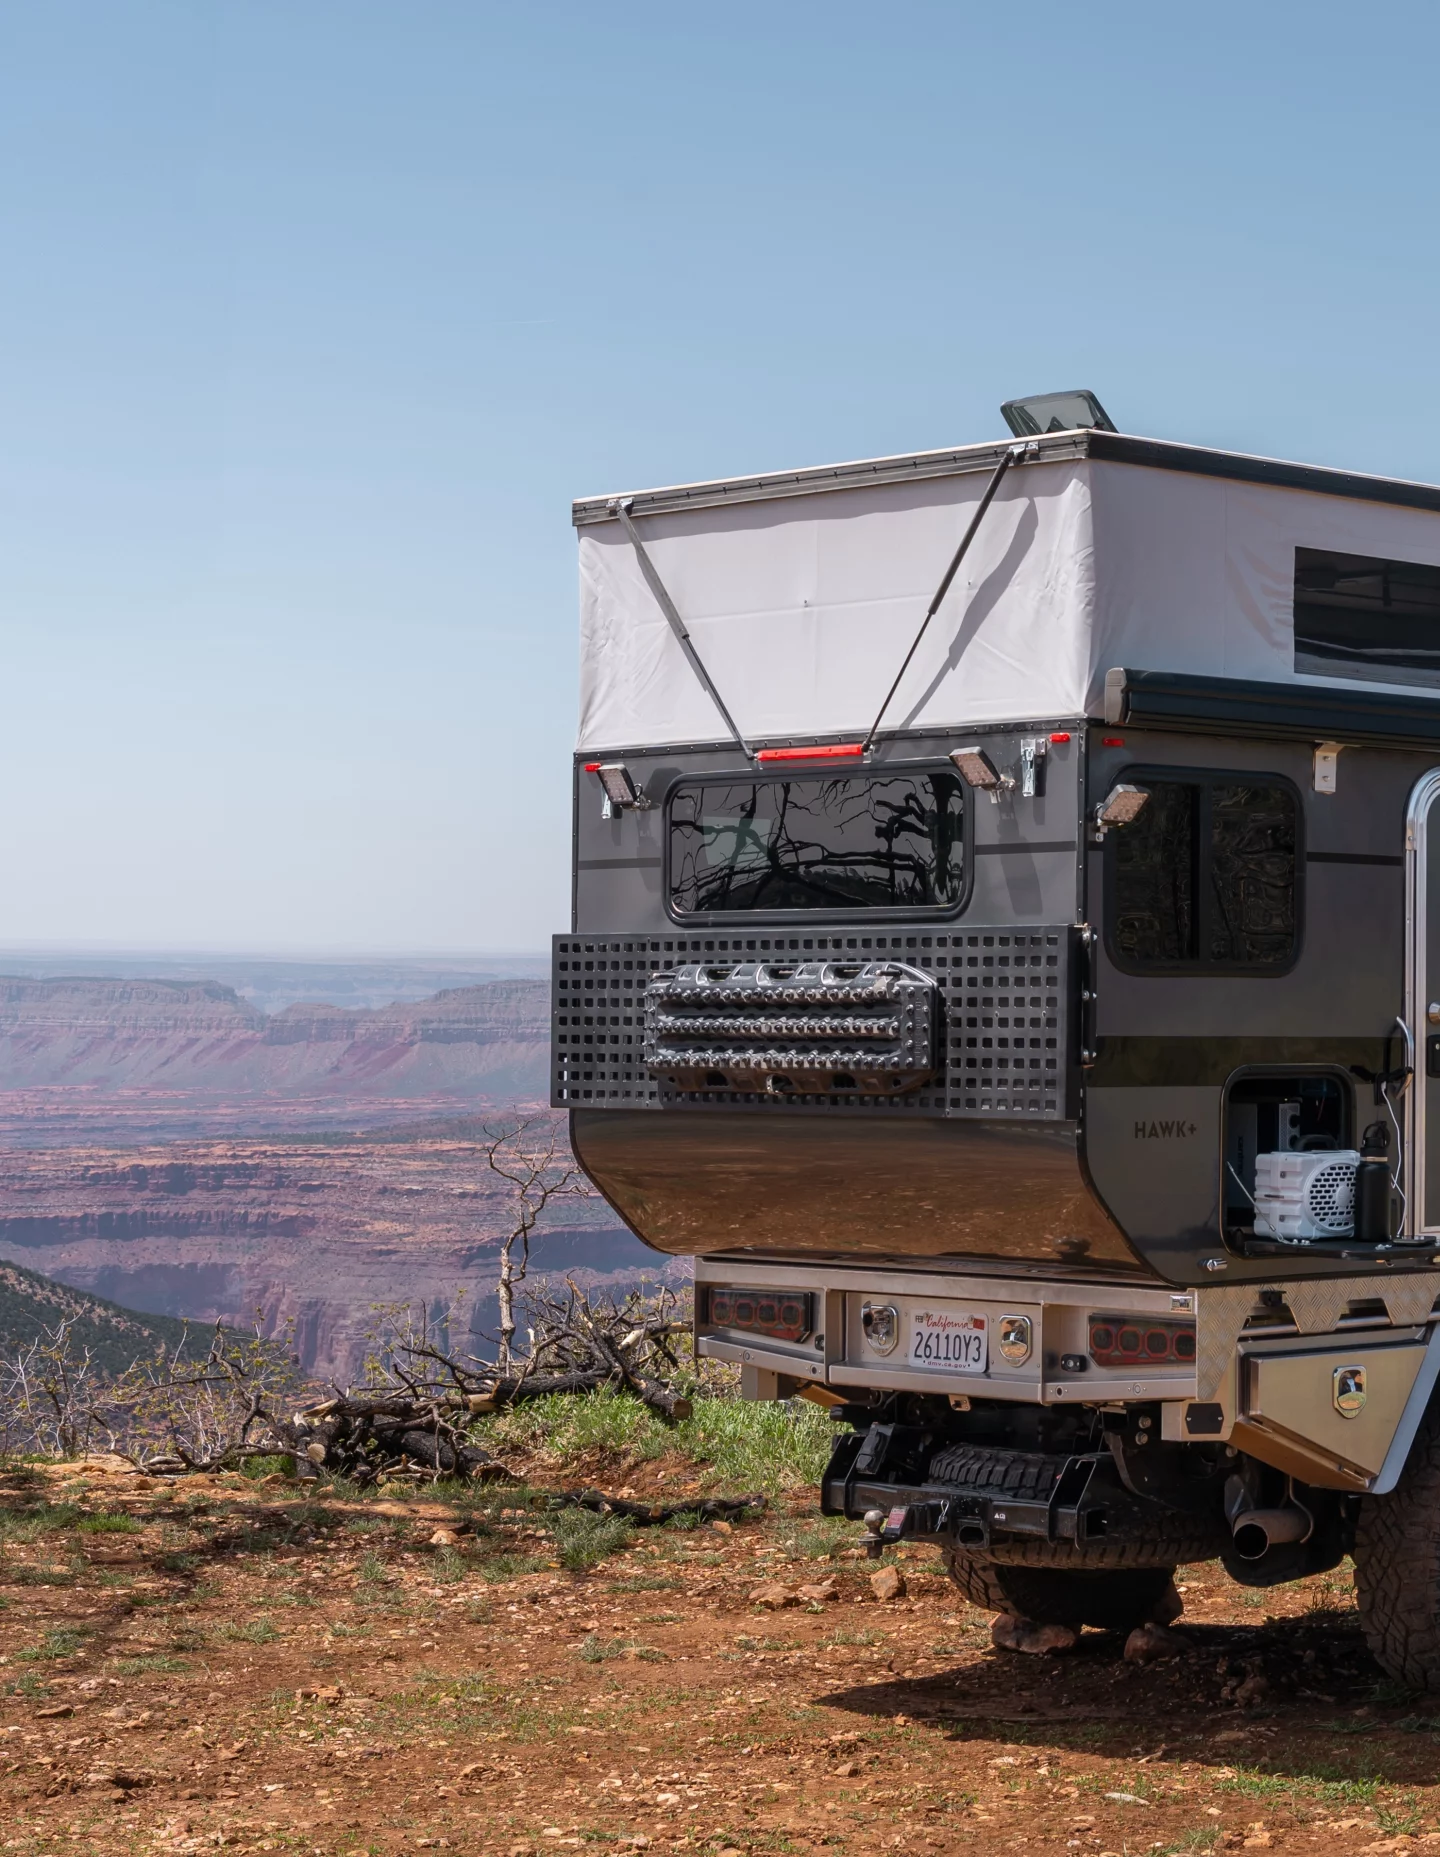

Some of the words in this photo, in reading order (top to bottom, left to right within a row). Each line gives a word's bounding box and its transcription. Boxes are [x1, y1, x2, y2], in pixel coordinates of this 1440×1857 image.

[1134, 1120, 1197, 1139] HAWK+
[926, 1313, 969, 1332] California
[914, 1331, 982, 1363] 26110Y3
[927, 1360, 967, 1369] dmv.ca.gov
